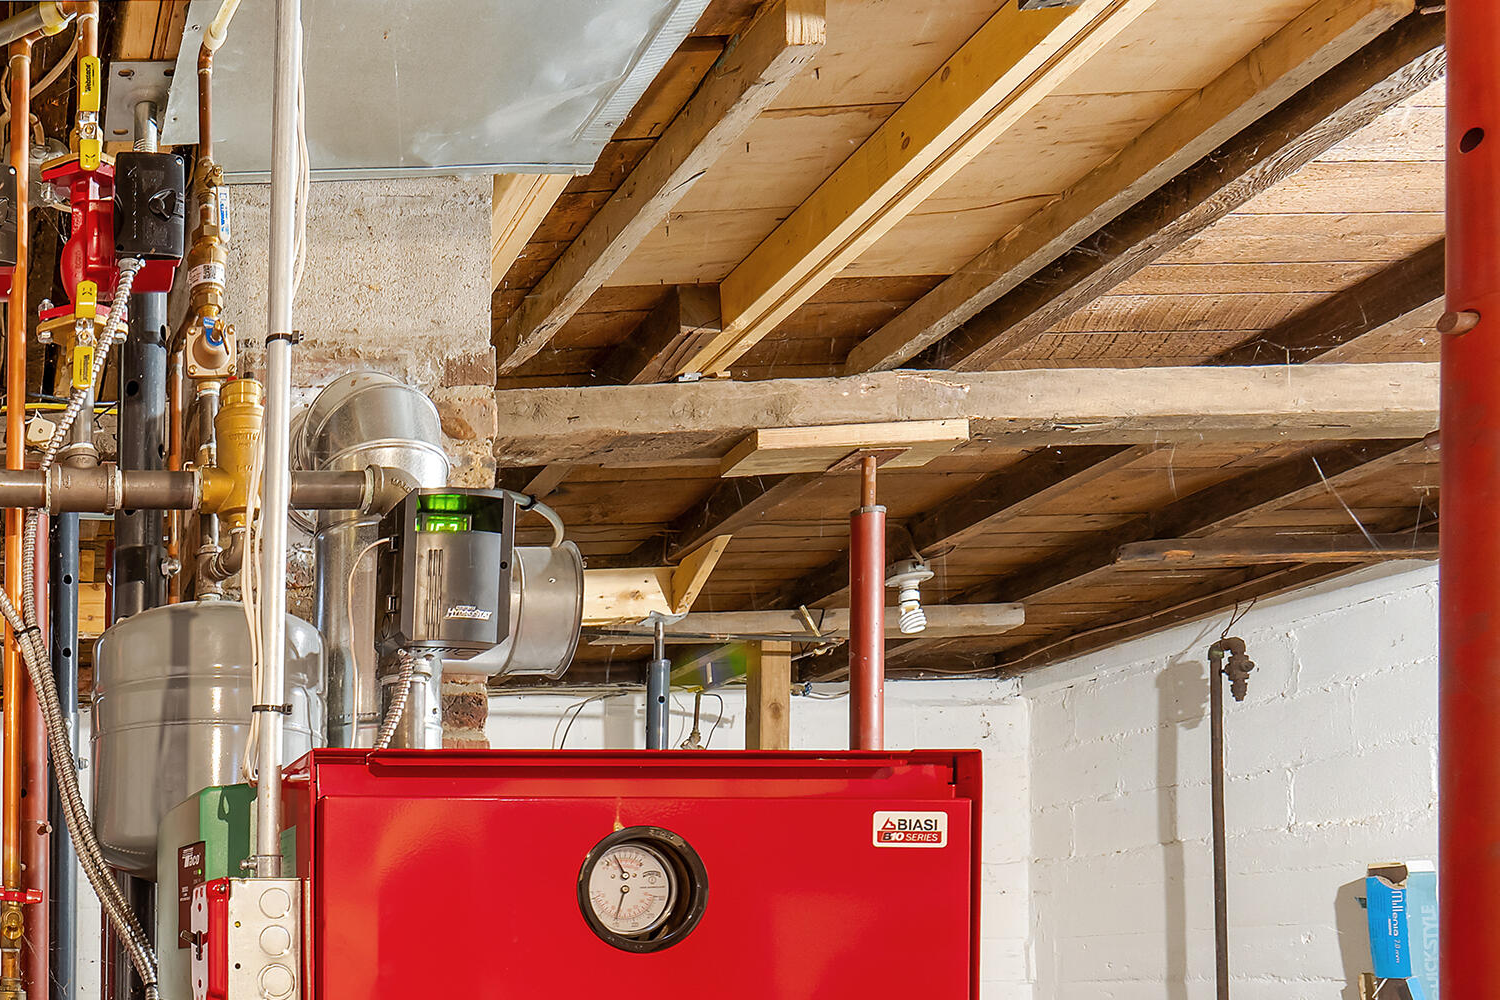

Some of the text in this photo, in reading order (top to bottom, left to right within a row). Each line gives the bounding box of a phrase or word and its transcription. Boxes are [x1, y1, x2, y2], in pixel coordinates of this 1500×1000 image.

[897, 818, 938, 831] BIASI
[882, 832, 939, 842] B10 SERIES
